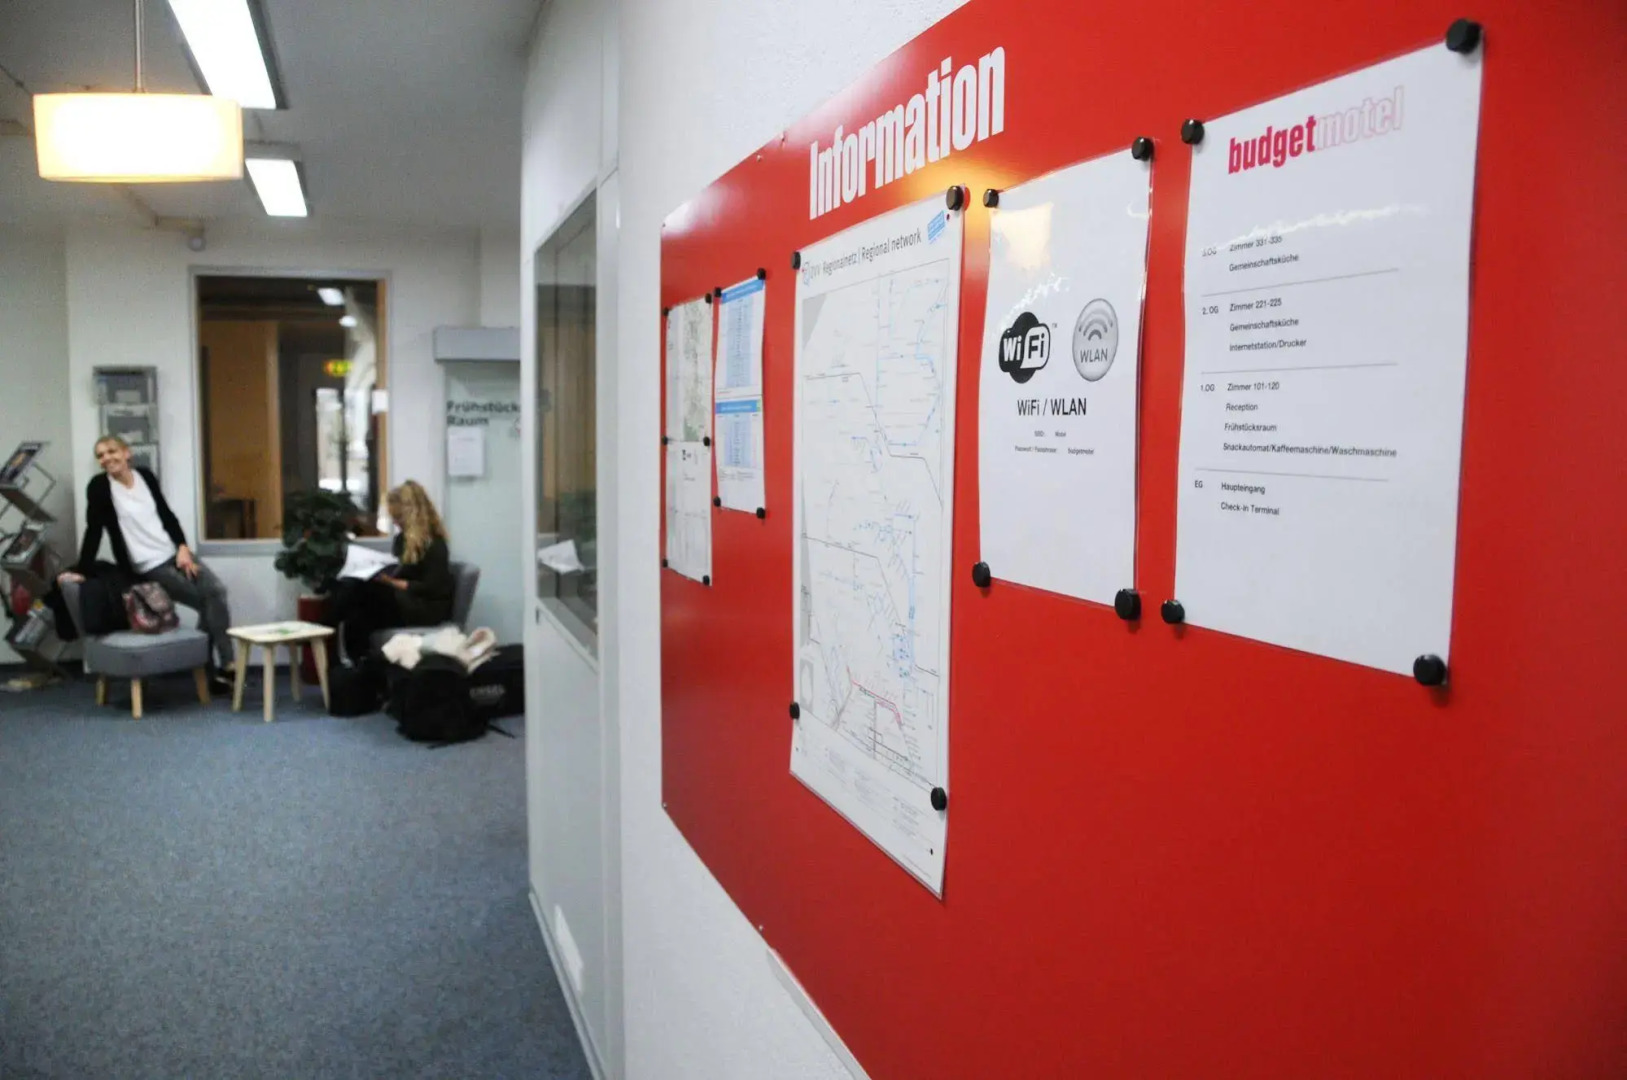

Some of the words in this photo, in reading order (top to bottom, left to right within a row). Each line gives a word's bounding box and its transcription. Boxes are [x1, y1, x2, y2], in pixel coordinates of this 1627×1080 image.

[809, 46, 1005, 220] Information
[1228, 85, 1405, 175] budgetmotel
[823, 252, 857, 276] Regionalnetz
[861, 238, 890, 262] Regional
[891, 227, 922, 252] network
[1229, 241, 1254, 252] Zimmer
[1229, 253, 1299, 272] Gemeinschaftsküche
[1229, 302, 1254, 312] Zimmer
[1255, 298, 1282, 309] 221-225
[1229, 318, 1299, 332] Gemeinschaftsküche
[1080, 348, 1108, 363] WLAN
[1227, 383, 1252, 392] Zimmer
[1253, 381, 1280, 391] 101-120
[1017, 399, 1040, 416] WiFi
[1050, 398, 1087, 416] WLAN
[1225, 402, 1258, 412] Reception
[446, 415, 489, 427] Raum
[1224, 422, 1277, 432] Frühstücksraum
[1223, 442, 1397, 458] Snackautomat/Kaffeemaschine/Waschmaschine
[1194, 480, 1203, 489] EG
[1221, 482, 1266, 495] Haupteingang
[1220, 501, 1249, 512] Check-in
[1250, 504, 1280, 516] Terminal
